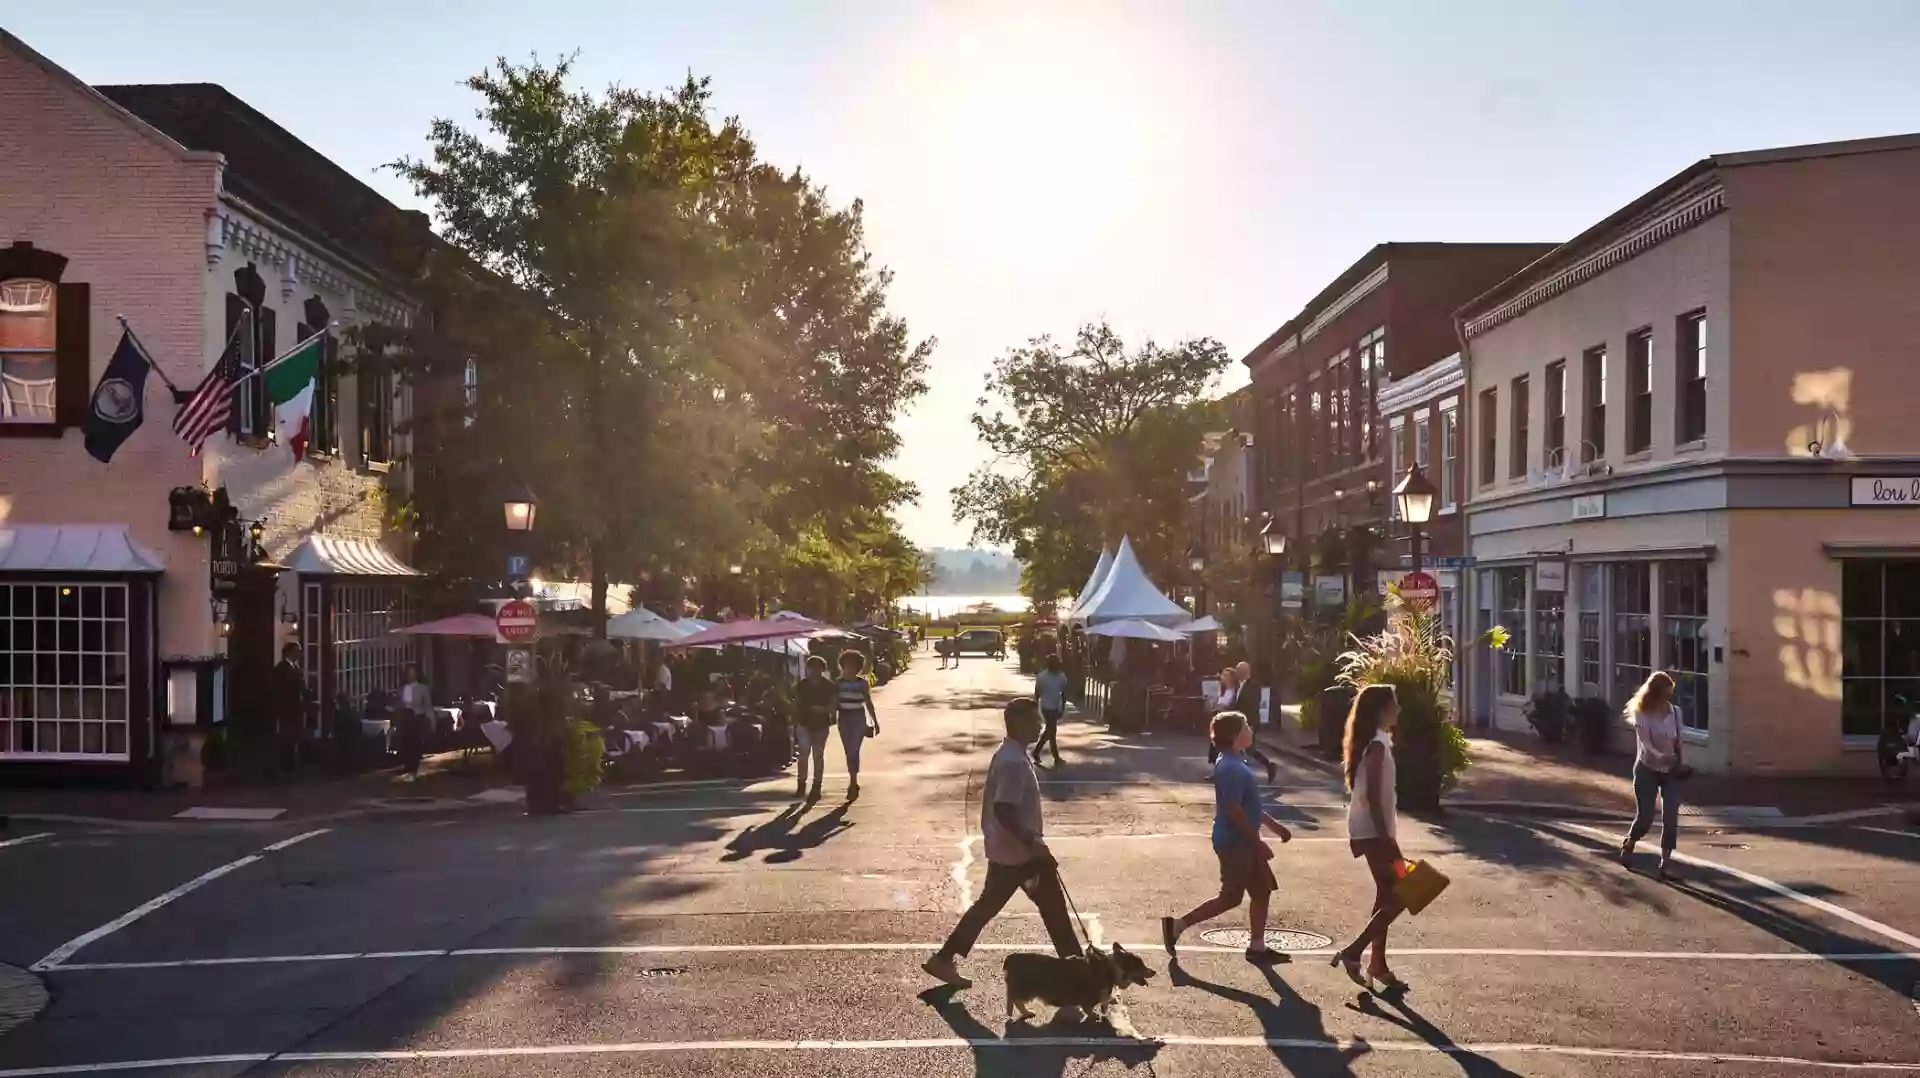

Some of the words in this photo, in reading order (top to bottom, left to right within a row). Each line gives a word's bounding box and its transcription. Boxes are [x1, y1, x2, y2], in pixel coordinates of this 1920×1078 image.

[1873, 480, 1907, 501] lou
[212, 559, 237, 575] PORTO
[512, 556, 525, 573] P
[502, 608, 513, 617] DO
[516, 606, 532, 617] NOT
